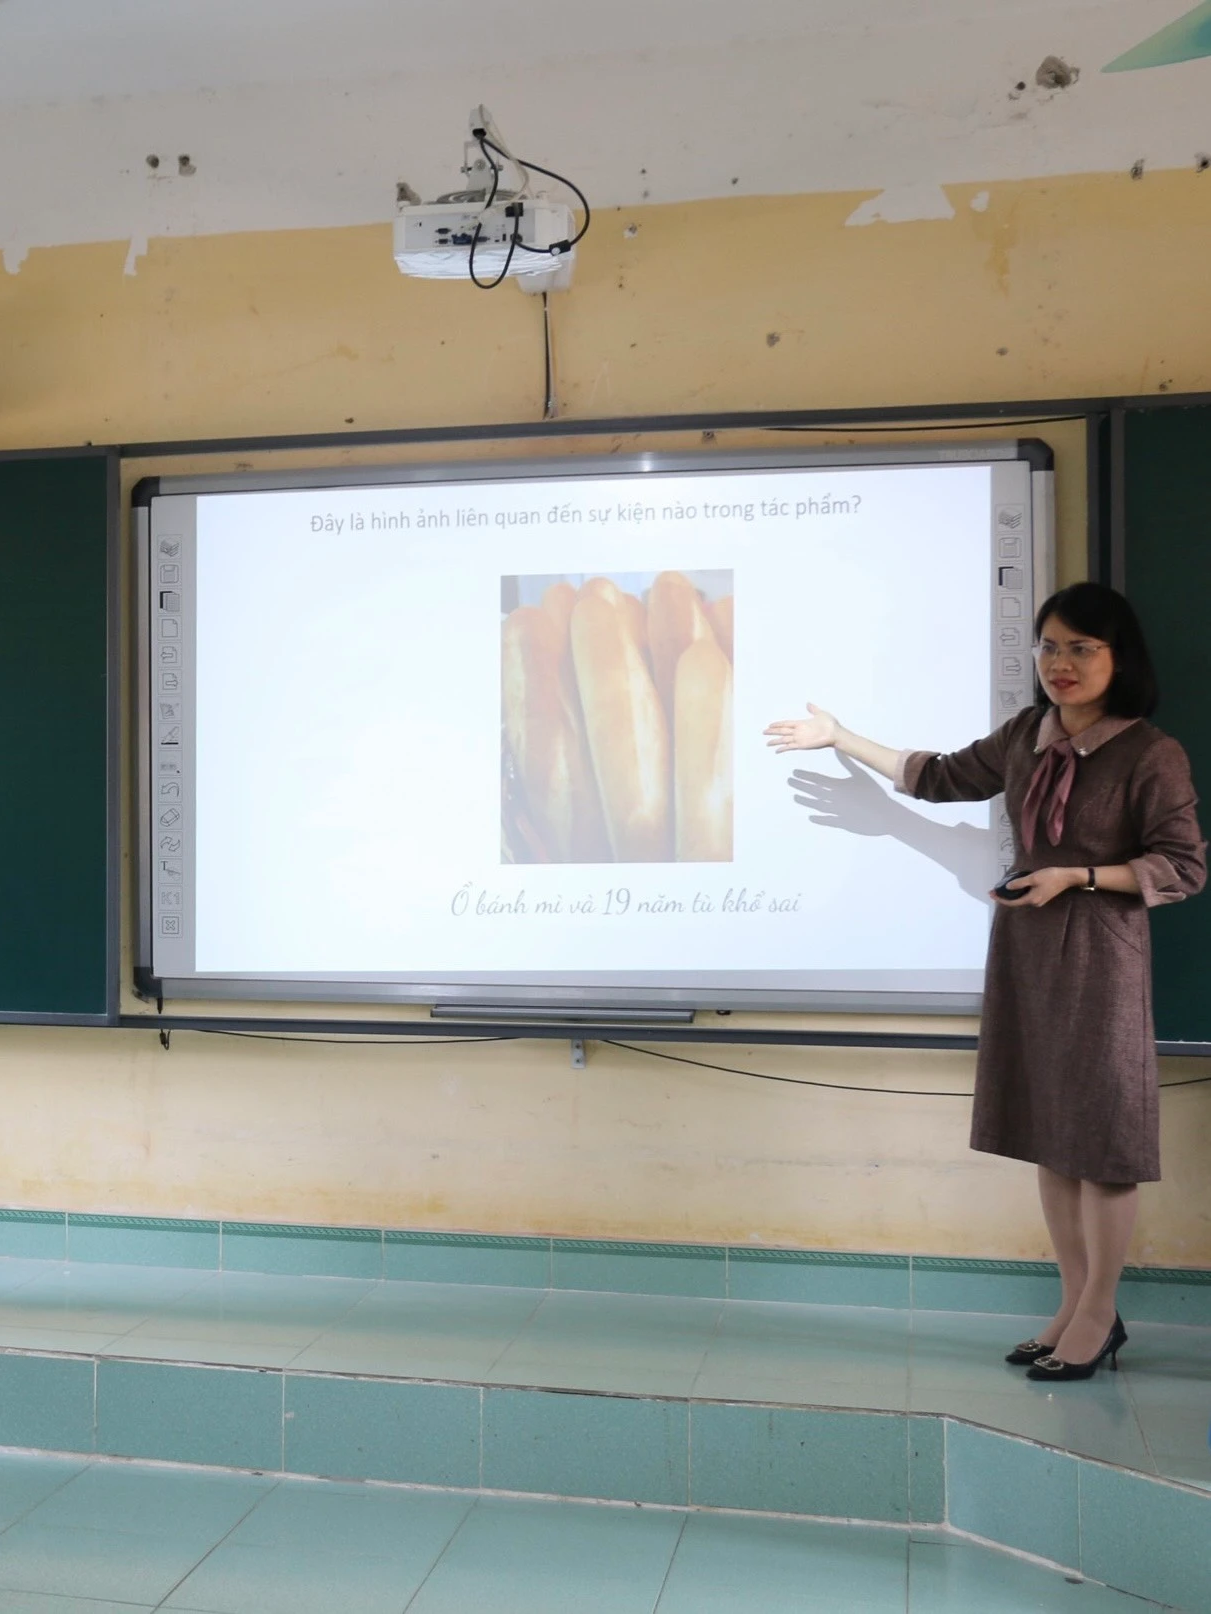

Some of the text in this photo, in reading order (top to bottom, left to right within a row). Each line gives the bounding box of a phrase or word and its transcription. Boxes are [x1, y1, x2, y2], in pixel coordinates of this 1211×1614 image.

[310, 493, 862, 535] Đây là hình ảnh liên quan đến sự kiện nào trong tác phẩm?
[475, 888, 528, 916] bánh
[534, 894, 563, 914] mì
[569, 894, 596, 914] và
[601, 887, 631, 916] 19
[637, 893, 685, 913] năm
[692, 892, 715, 913] tù
[721, 888, 766, 913] khổ
[768, 892, 802, 913] sai
